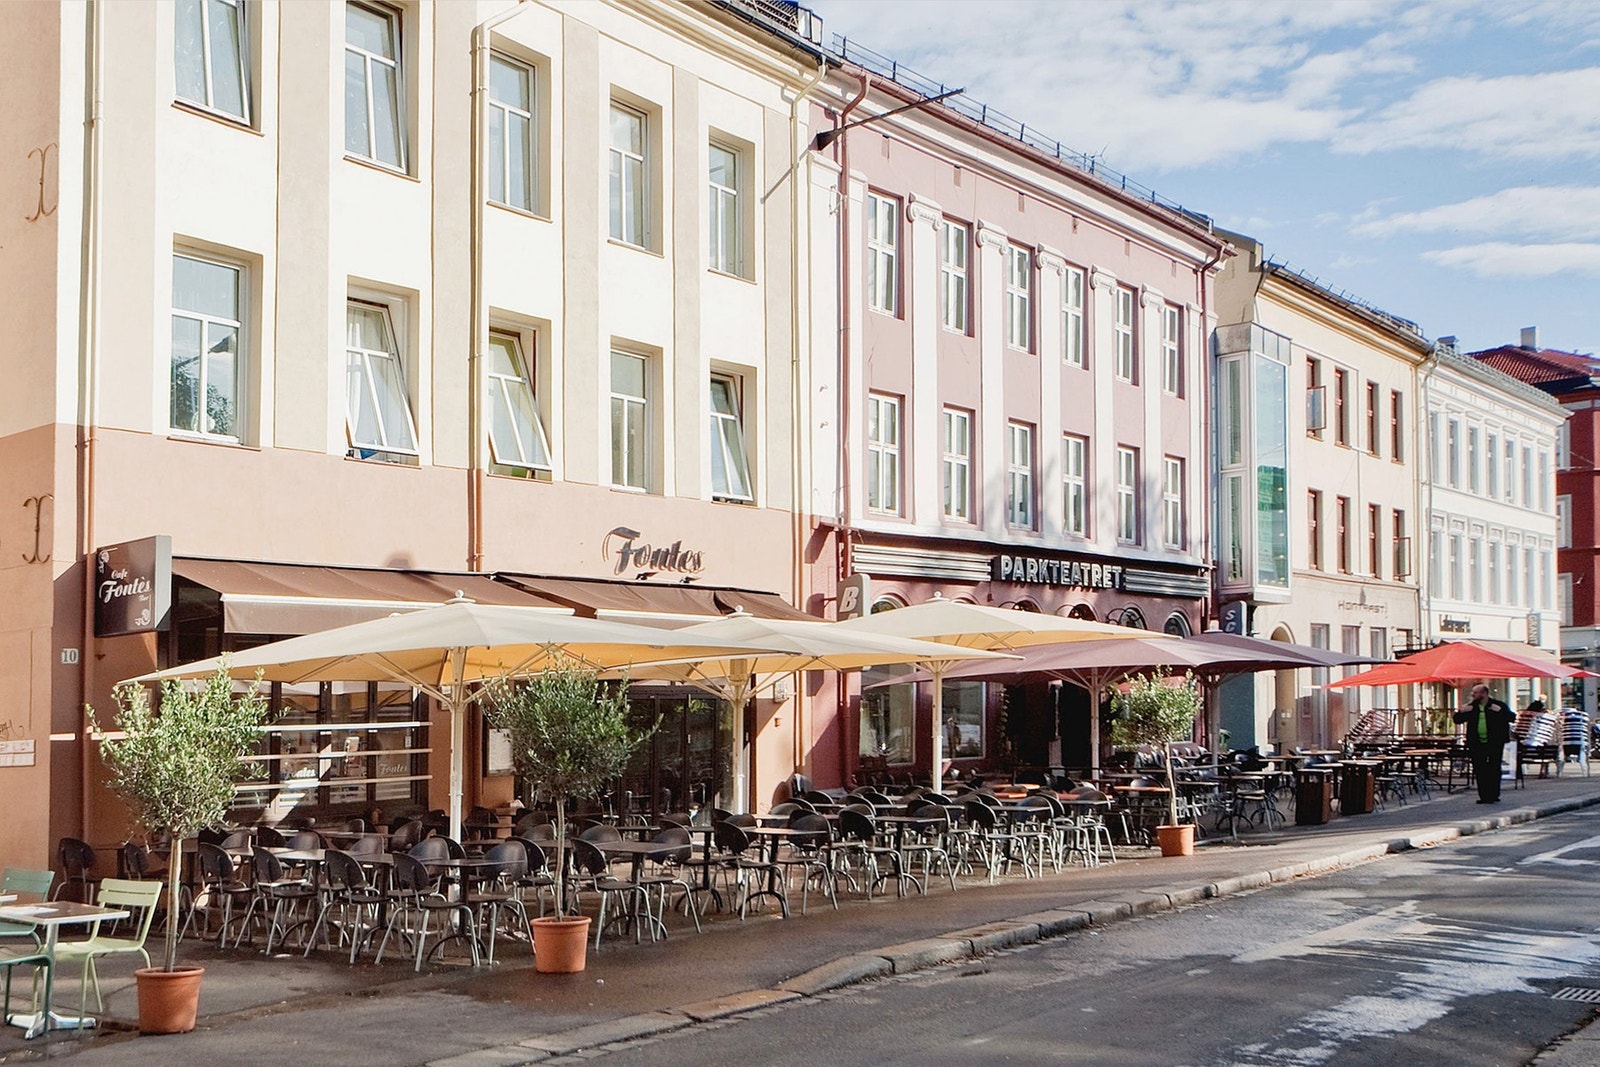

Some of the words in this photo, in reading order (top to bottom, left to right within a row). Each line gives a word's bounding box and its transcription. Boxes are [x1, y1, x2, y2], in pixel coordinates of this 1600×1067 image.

[1000, 554, 1122, 589] PARKTEATRET
[839, 586, 859, 619] B
[63, 649, 77, 662] 10
